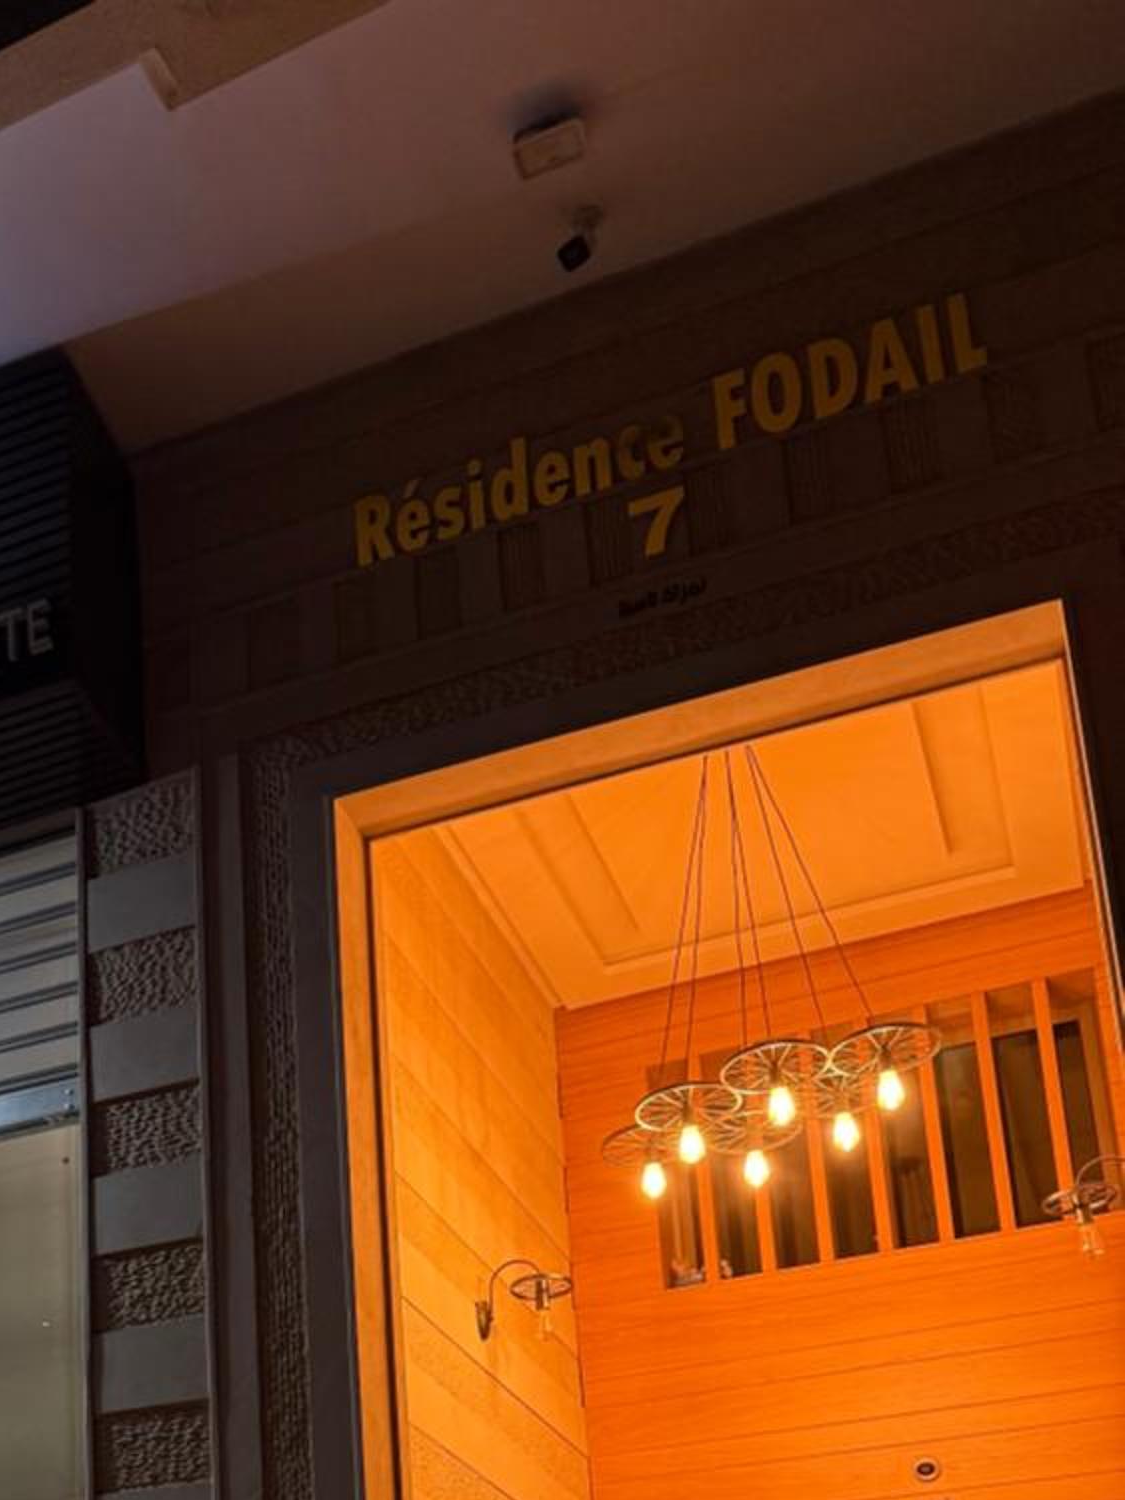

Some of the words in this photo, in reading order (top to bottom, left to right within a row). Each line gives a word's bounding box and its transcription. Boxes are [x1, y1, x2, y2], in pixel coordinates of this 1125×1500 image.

[352, 416, 686, 568] Résidence
[709, 292, 988, 451] FODAIL
[627, 485, 685, 558] 7
